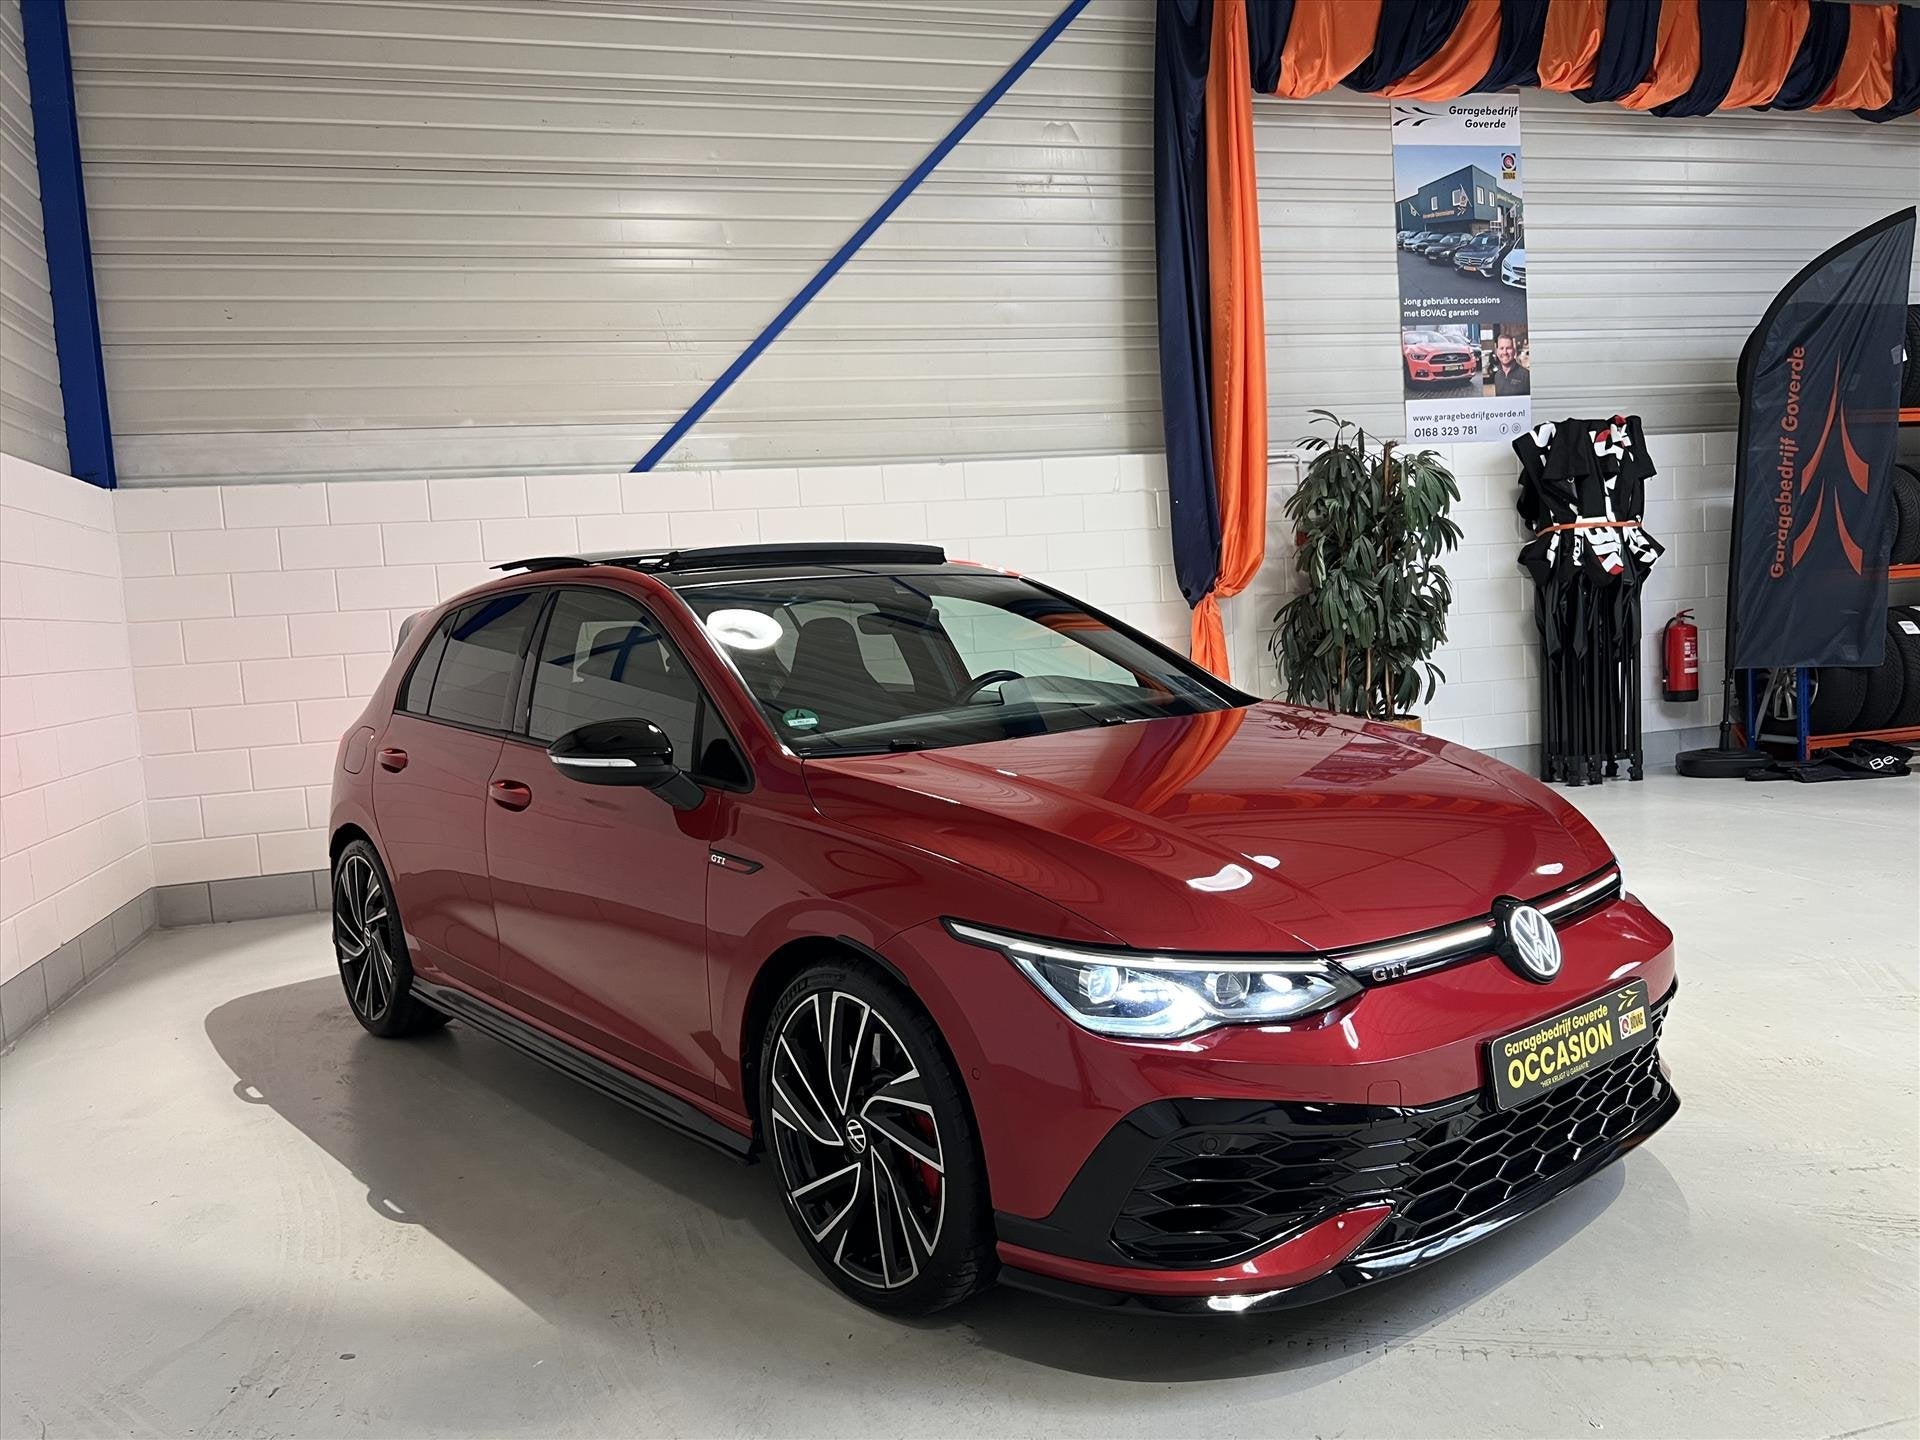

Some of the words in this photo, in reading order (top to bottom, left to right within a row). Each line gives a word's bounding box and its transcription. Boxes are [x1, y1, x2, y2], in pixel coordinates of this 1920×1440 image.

[1449, 105, 1518, 117] Garagebedrijf
[1465, 119, 1506, 128] Goverde
[1403, 298, 1421, 307] Jong
[1422, 297, 1458, 307] gebruikte
[1420, 308, 1447, 317] BOVAG
[1448, 308, 1479, 318] garantie
[1781, 346, 1806, 432] Goverde
[1413, 409, 1526, 422] www.garagebedrijfgoverde.nl
[1414, 428, 1438, 437] 0168
[1441, 426, 1460, 436] 329
[1462, 425, 1478, 435] 781
[1770, 437, 1799, 579] Garagebedrijf
[711, 854, 726, 865] GTI
[1372, 960, 1409, 982] GTI
[1504, 1017, 1572, 1057] Garagebedrijf
[1572, 1004, 1609, 1028] Goverde
[1508, 1019, 1613, 1089] OCCASION
